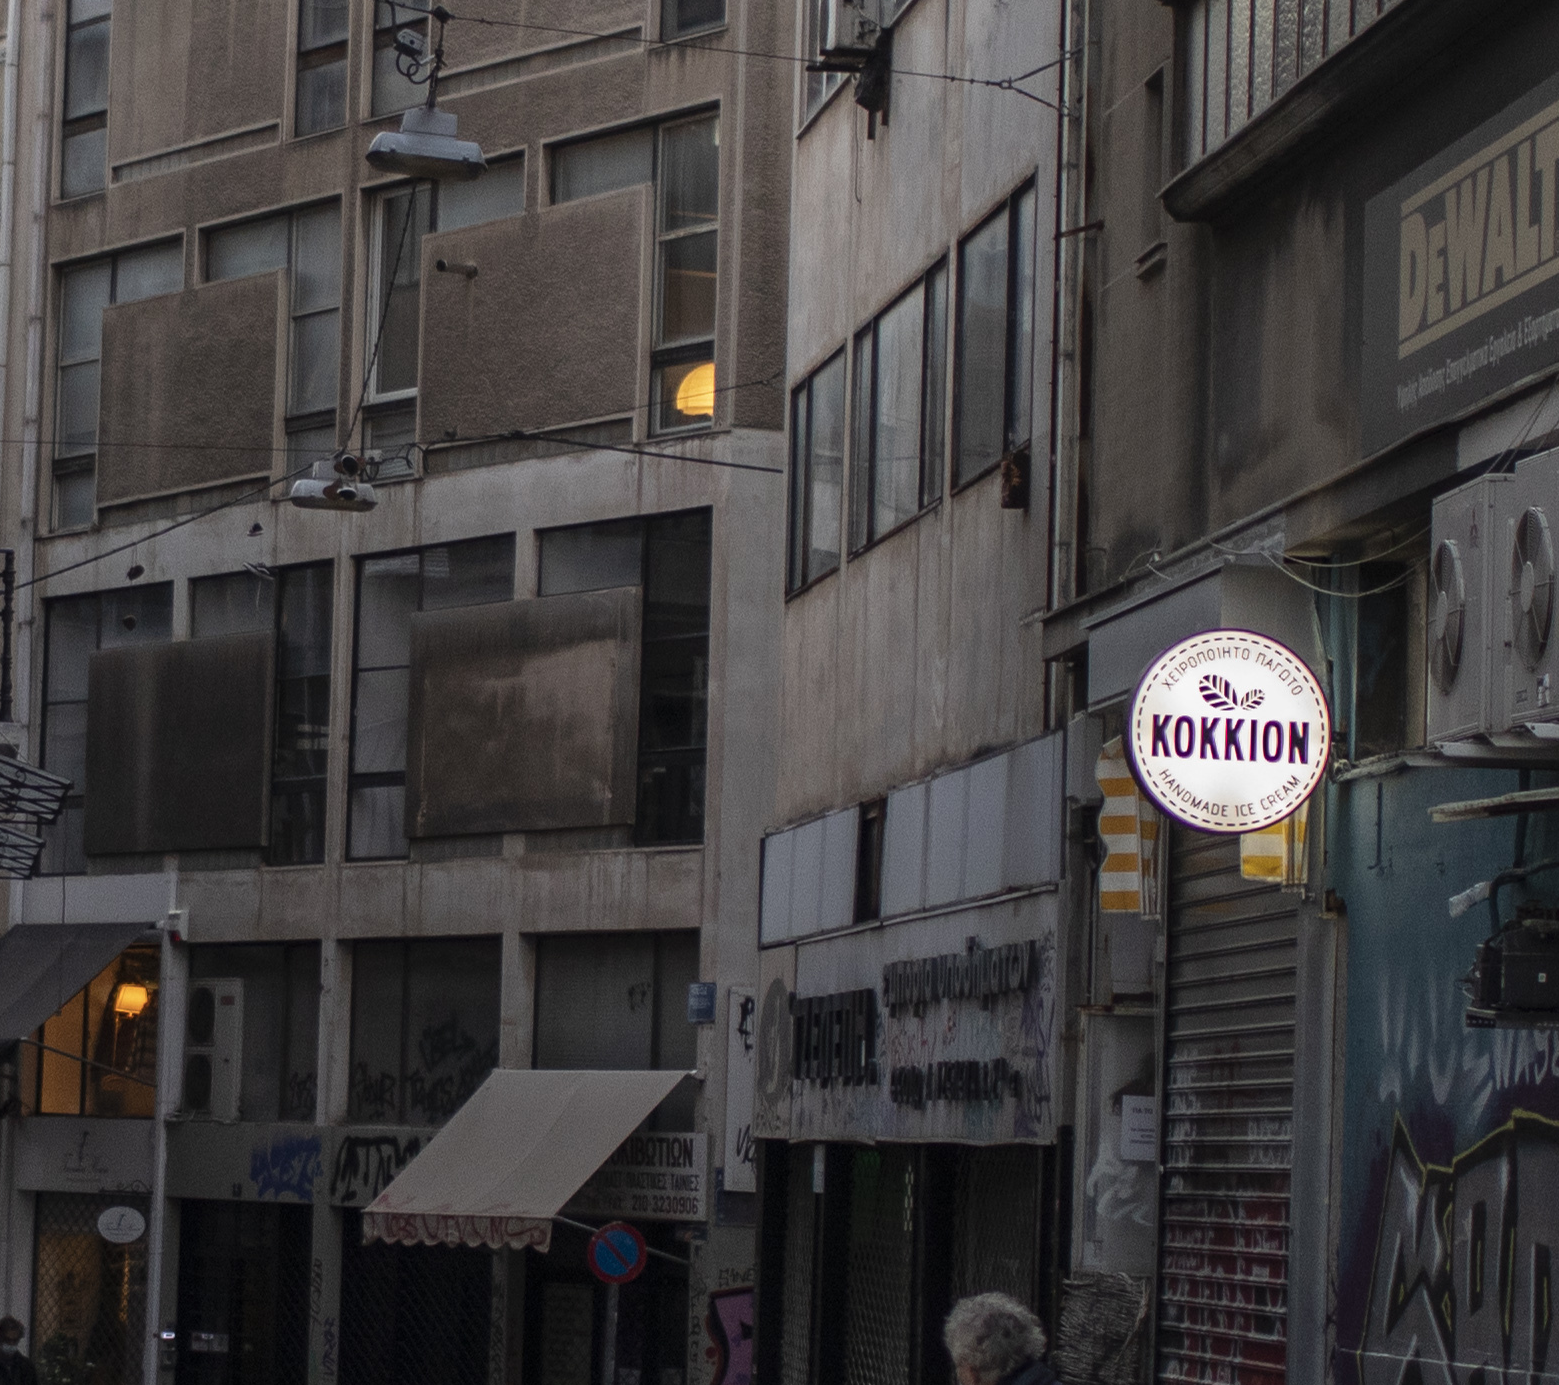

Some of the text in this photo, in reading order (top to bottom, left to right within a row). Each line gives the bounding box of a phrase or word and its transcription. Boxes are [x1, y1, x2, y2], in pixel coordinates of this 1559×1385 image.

[1151, 714, 1309, 764] KOKKION
[1159, 768, 1302, 818] HANDMADE ICE CREAM
